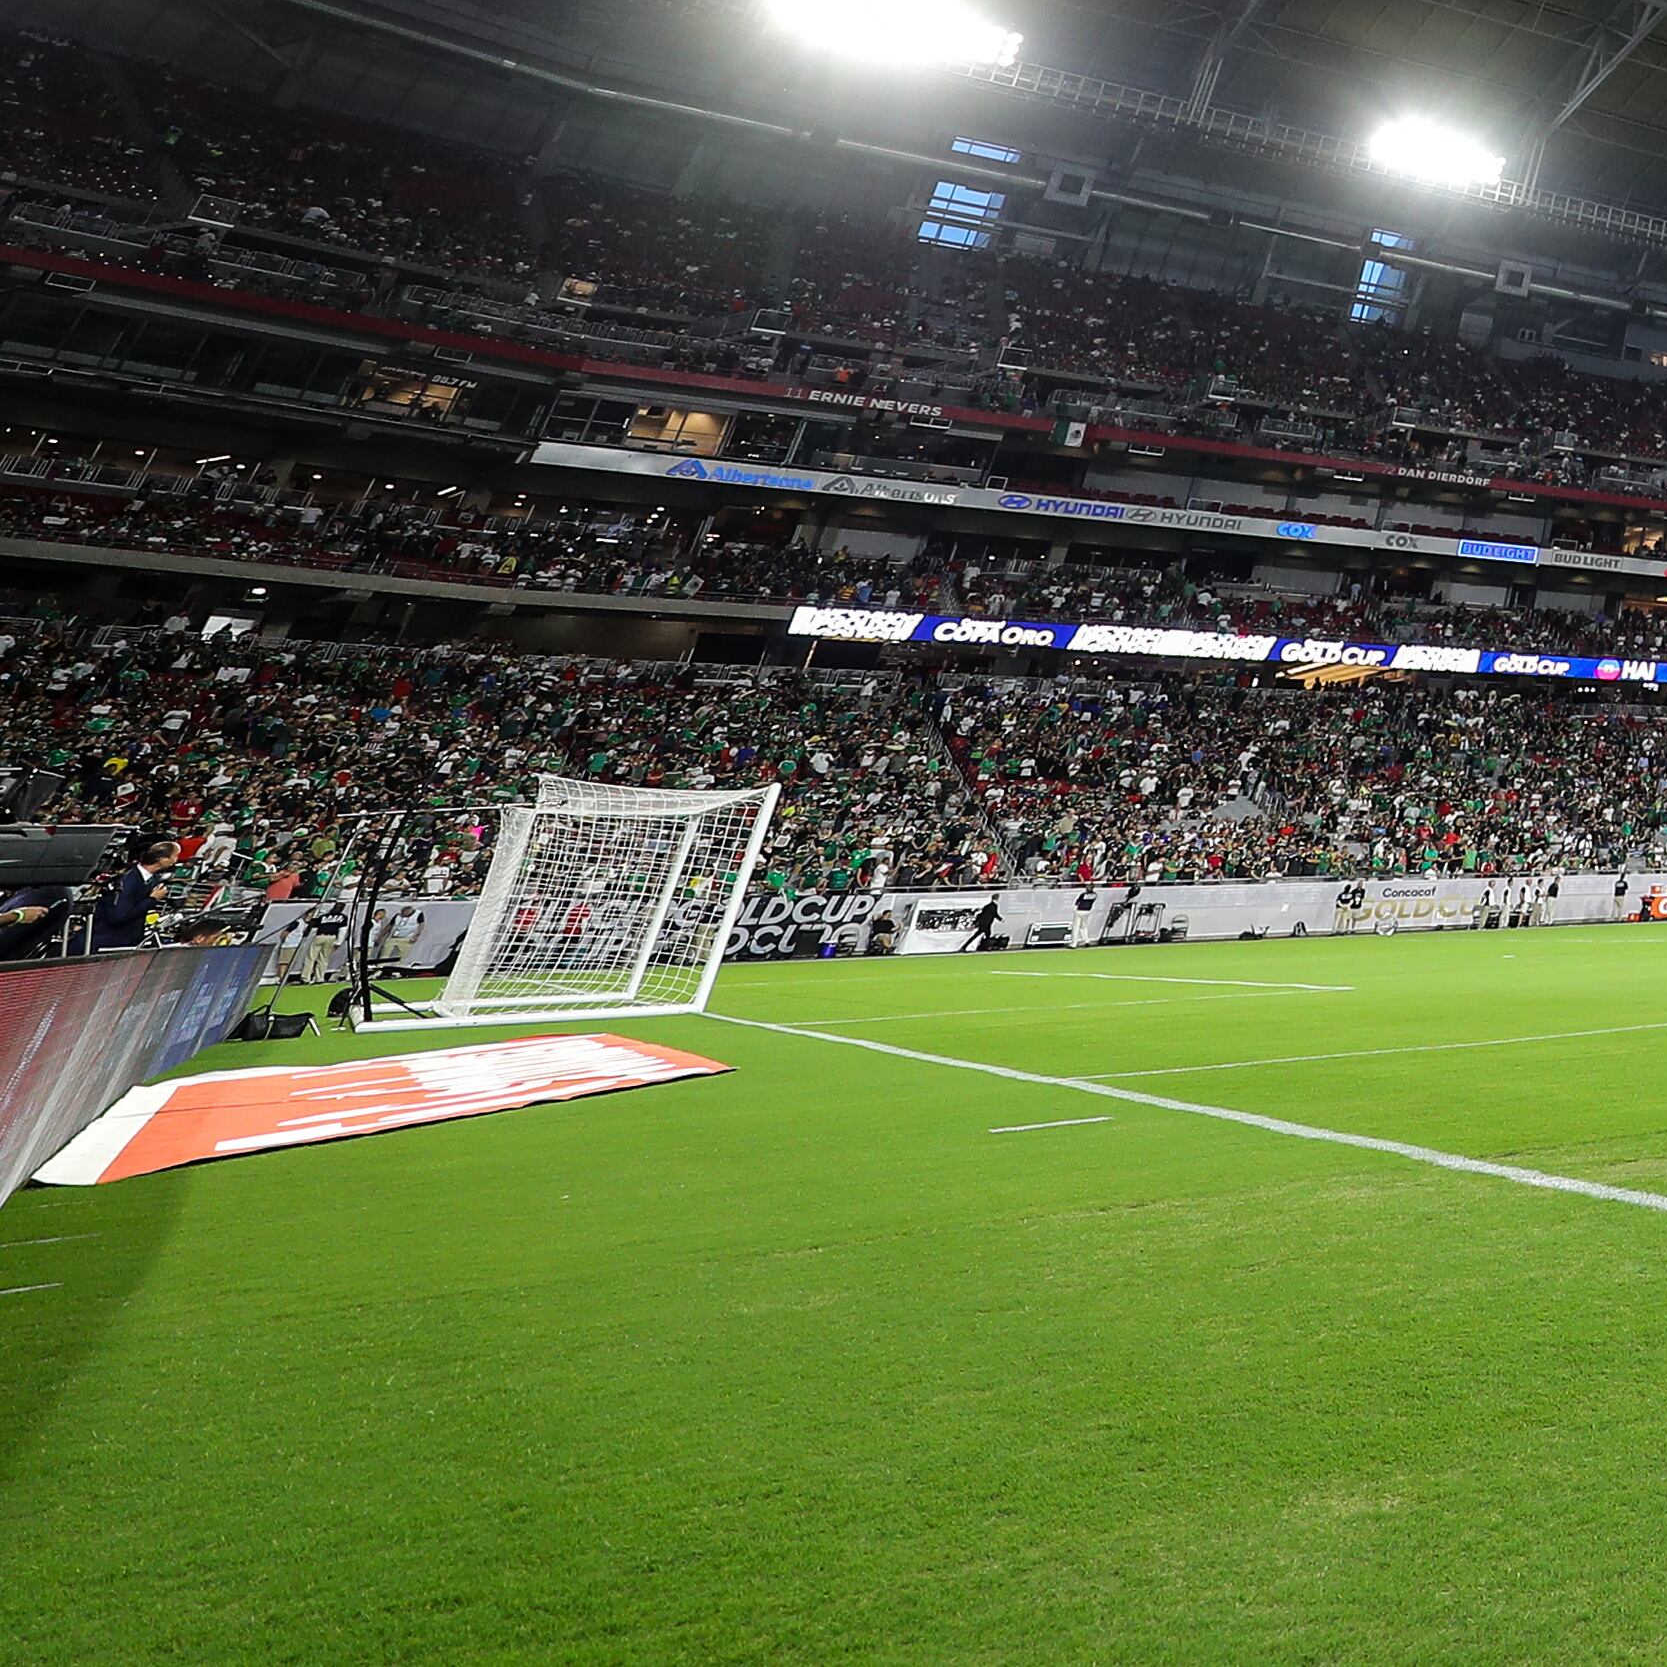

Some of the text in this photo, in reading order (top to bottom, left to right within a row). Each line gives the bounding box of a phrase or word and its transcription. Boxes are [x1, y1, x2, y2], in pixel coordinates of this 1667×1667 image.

[809, 390, 867, 408] ERNIE
[869, 398, 943, 418] NEVERS
[1398, 467, 1425, 479] DAN
[1428, 471, 1491, 487] DIERDORF
[1035, 498, 1126, 520] HYUNDAI
[1160, 511, 1243, 531] HYUNDAI
[1276, 522, 1317, 539] COX
[1384, 534, 1418, 549] COX
[1462, 542, 1535, 561] BUD LIGHT
[1553, 552, 1622, 569] BUD LIGHT
[934, 621, 1003, 644] COPA
[1001, 624, 1055, 647] ORO
[1280, 642, 1343, 665] GOLD
[1341, 647, 1387, 666] CUP
[1494, 655, 1537, 675] GOLD
[1537, 660, 1570, 677] CUP
[1622, 660, 1655, 682] HAI
[1382, 886, 1437, 898] Concacaf
